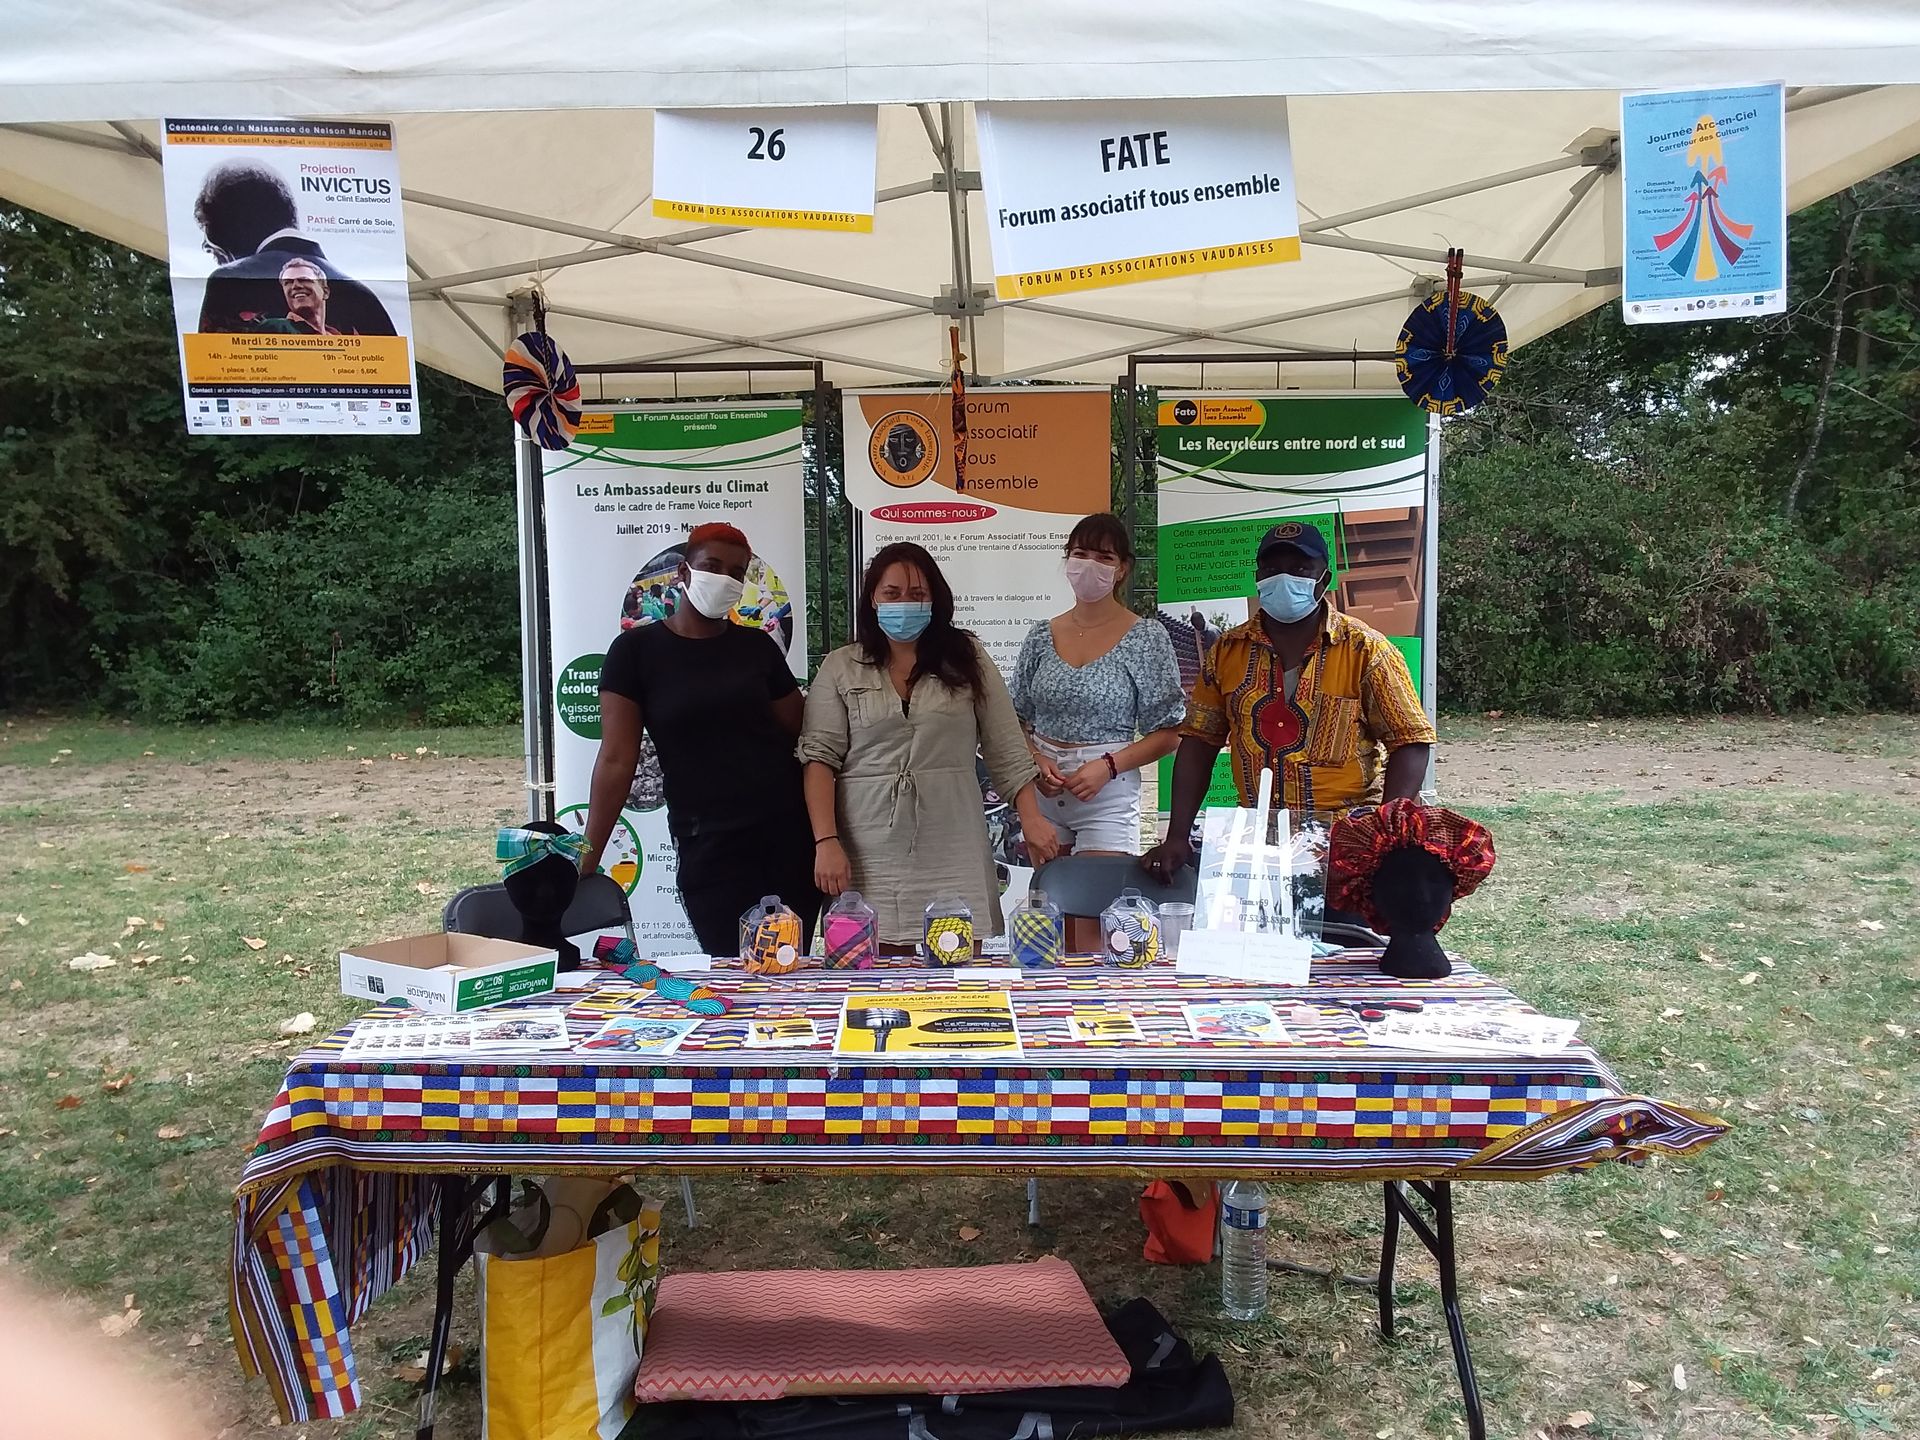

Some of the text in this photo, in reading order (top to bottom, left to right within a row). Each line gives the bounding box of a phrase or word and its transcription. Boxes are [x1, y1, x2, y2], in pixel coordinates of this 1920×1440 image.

[168, 123, 387, 137] Centenaire de la Naissance de Nelson Mandela
[1646, 109, 1758, 145] Journée Arc-en-Ciel
[747, 127, 786, 162] 26
[1658, 124, 1750, 153] Carrefour des Cultures
[1100, 130, 1171, 173] FATE
[300, 163, 356, 175] Projection
[300, 176, 392, 195] INVICTUS
[336, 195, 354, 203] Clint
[355, 195, 391, 204] Eastwood
[999, 172, 1281, 229] Forum associatif tous ensemble
[671, 203, 856, 223] FORUM DES ASSOCIATIONS VAUDAISES
[307, 215, 336, 225] PATHÉ
[338, 217, 361, 225] Carré
[362, 218, 373, 226] de
[1019, 242, 1275, 287] FORUM DES ASSOCIATIONS VAUDAISES
[231, 337, 361, 347] Mardi 26 novembre 2019
[207, 352, 222, 360] 14h
[254, 353, 279, 361] public
[343, 354, 360, 362] Tout
[361, 354, 385, 363] public
[966, 401, 1010, 414] orum
[1174, 407, 1197, 416] Fate
[632, 411, 768, 422] Le Forum Associatif Tous Ensemble
[683, 423, 717, 433] présente
[967, 424, 1039, 439] ssociatif
[1178, 435, 1406, 455] Les Recycleurs entre nord et sud
[968, 452, 997, 465] ous
[576, 480, 770, 497] Les Ambassadeurs du Climat
[967, 474, 1039, 490] nsemble
[594, 499, 753, 513] dans le cadre de Frame Voice Report
[880, 507, 900, 519] Qui
[901, 507, 978, 519] sommes-nous
[616, 523, 644, 535] Juillet
[646, 523, 671, 534] 2019
[1173, 529, 1195, 538] Cette
[1197, 525, 1238, 537] exposition
[1241, 524, 1254, 532] est
[875, 534, 893, 542] Créé
[960, 533, 985, 541] Forum
[987, 532, 1026, 540] Associatif
[1028, 532, 1047, 540] Tous
[1173, 536, 1250, 549] co-construite avec
[928, 544, 938, 552] de
[940, 544, 955, 553] plus
[956, 543, 977, 552] d'une
[978, 543, 1011, 551] trentaine
[1174, 547, 1251, 561] du Climat dans le
[1175, 559, 1237, 572] FRAME VOICE
[1175, 571, 1246, 584] Forum Associatif
[1192, 585, 1208, 594] des
[1004, 594, 1035, 603] dialogue
[965, 618, 1006, 626] d'éducation
[992, 640, 1003, 648] de
[566, 667, 603, 680] Transi
[561, 681, 599, 697] écolog
[641, 922, 651, 930] 67
[677, 921, 686, 929] 06
[492, 974, 504, 986] 80
[508, 977, 549, 993] NAVIGATOR
[406, 986, 446, 1004] NAVIGATOR
